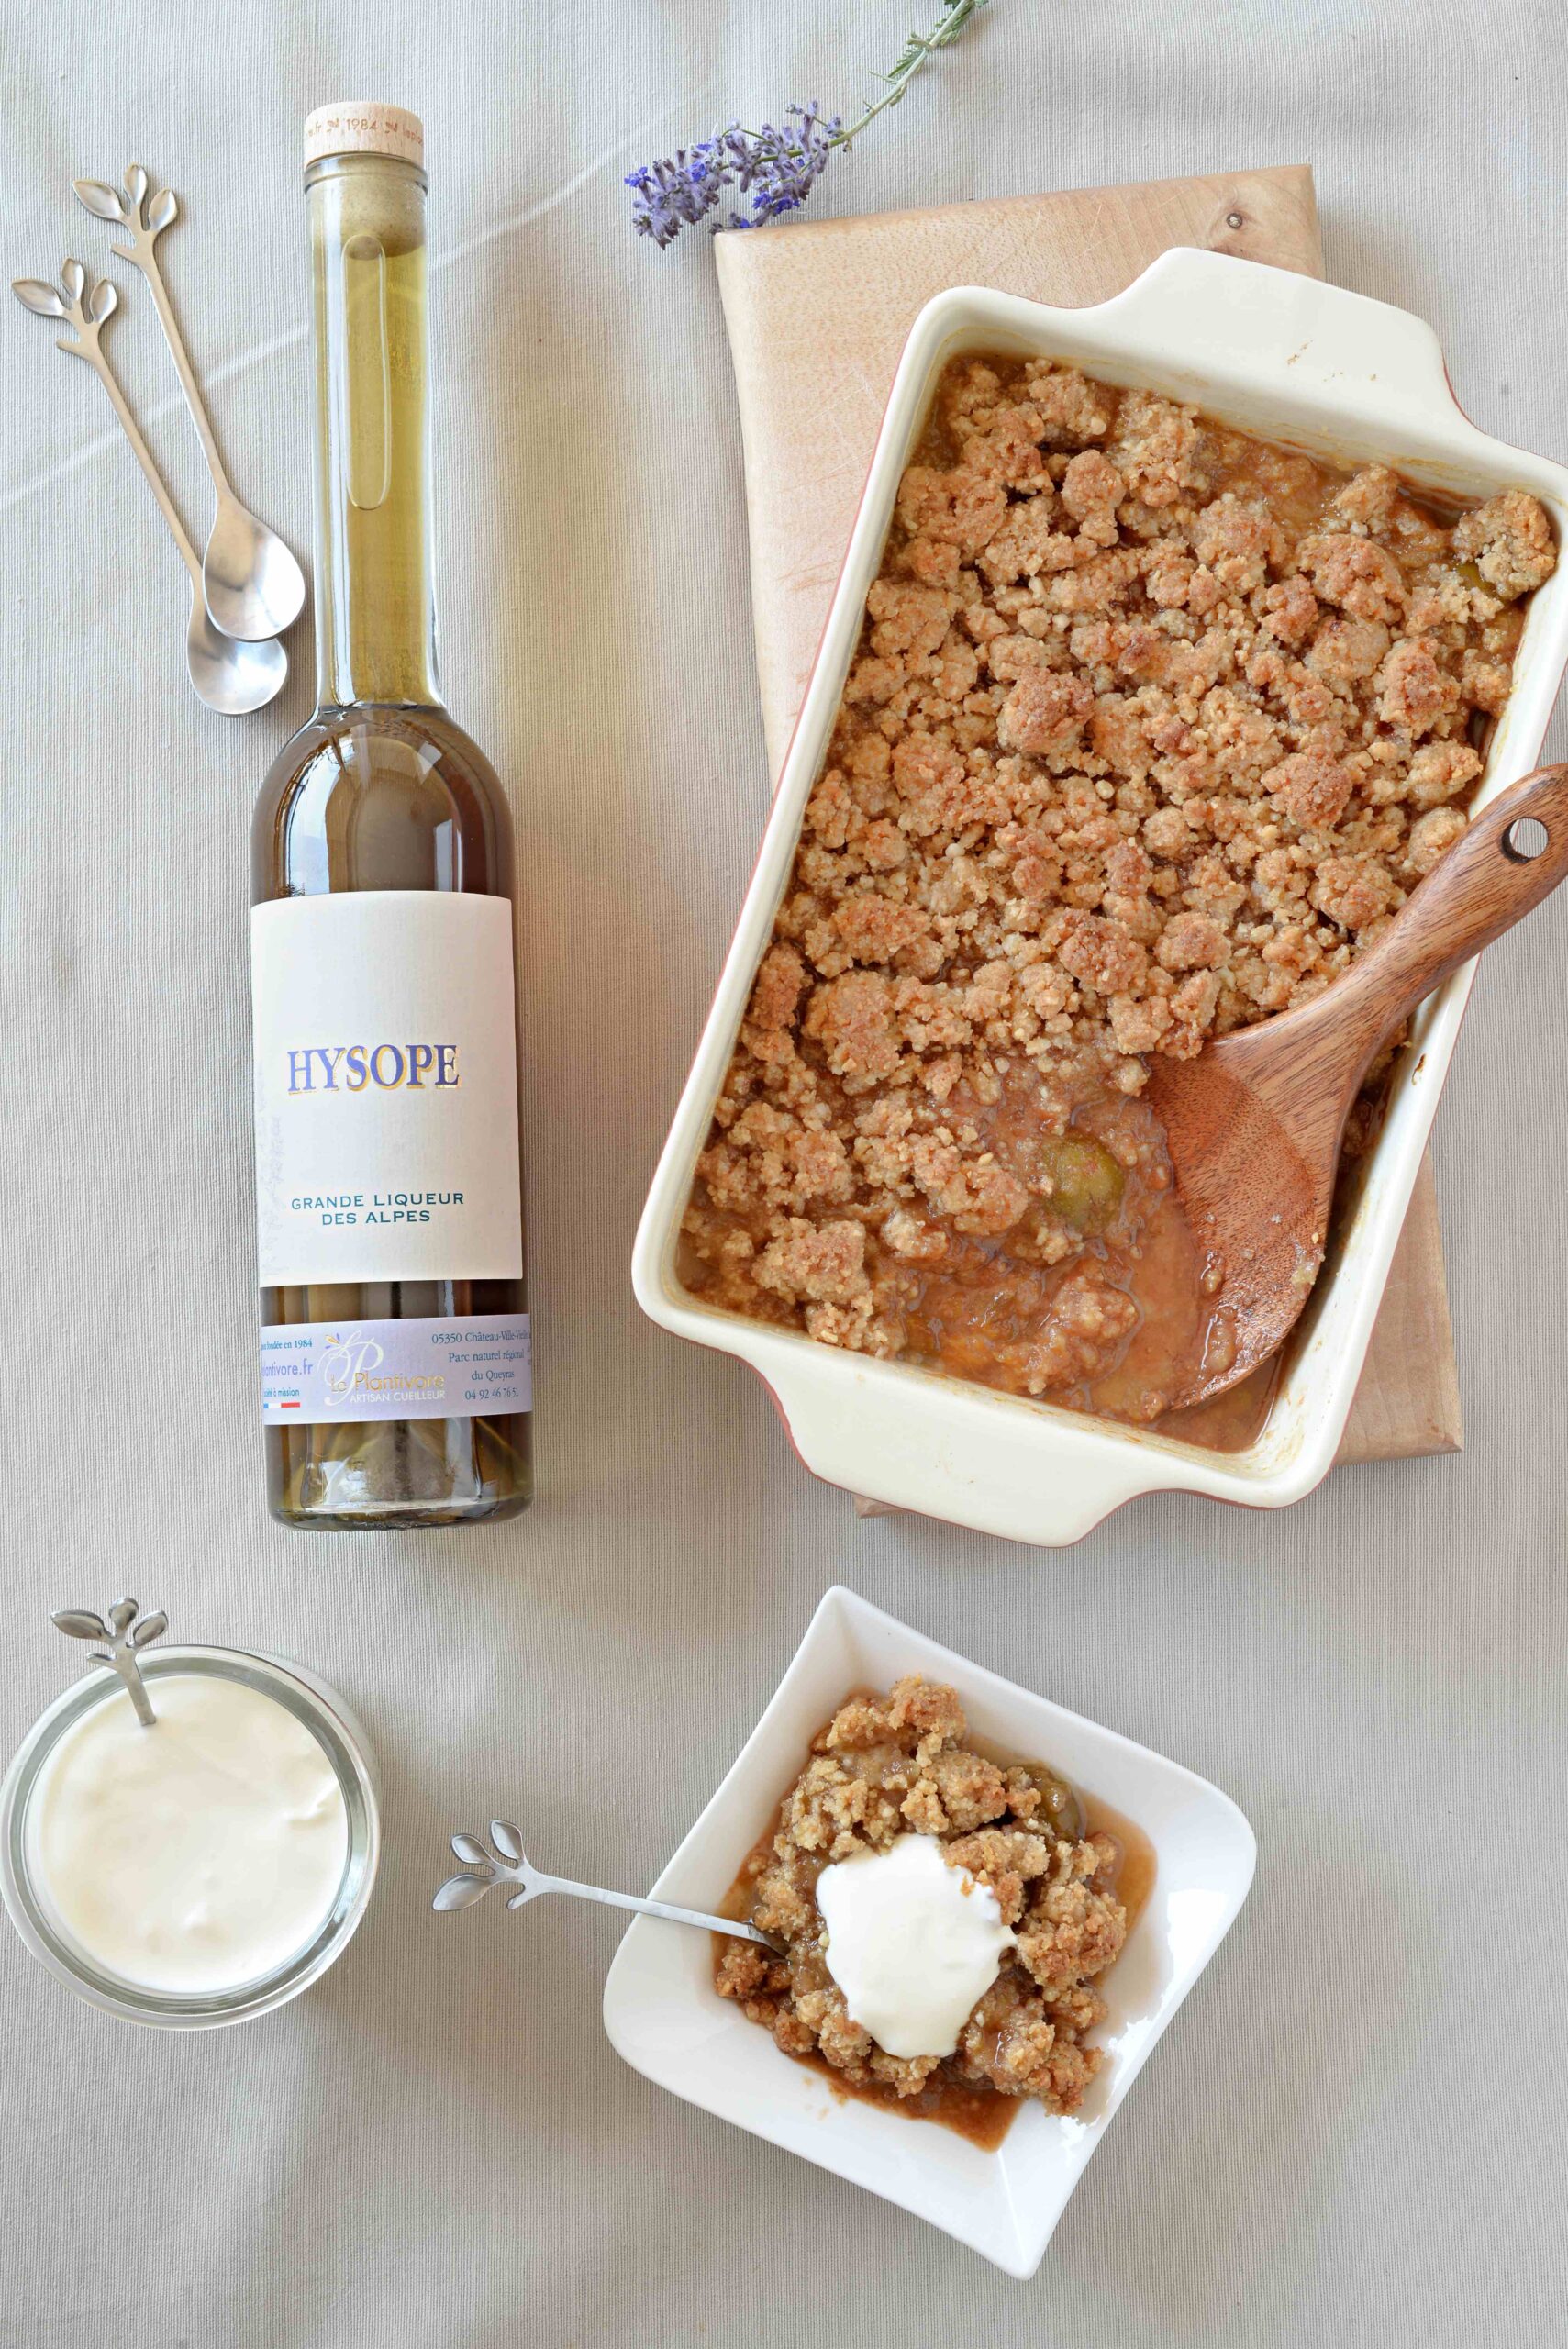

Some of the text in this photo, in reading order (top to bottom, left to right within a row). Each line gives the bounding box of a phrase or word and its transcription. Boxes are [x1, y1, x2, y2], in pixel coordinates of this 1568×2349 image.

[346, 118, 378, 130] 1984
[287, 1043, 460, 1095] HYSOPE
[291, 1192, 464, 1210] GRANDE LIQUEUR
[322, 1209, 431, 1226] DES ALPES
[294, 1338, 313, 1349] 1984
[431, 1333, 462, 1344] 05350
[448, 1353, 470, 1363] Parc
[473, 1351, 501, 1362] naturel
[354, 1371, 446, 1391] Plantivore
[471, 1370, 515, 1382] du Queyras
[278, 1386, 300, 1397] mission
[350, 1390, 446, 1404] ARTISAN CUEILLEUR
[465, 1389, 476, 1400] 04
[479, 1389, 490, 1400] 92
[492, 1387, 502, 1398] 46
[512, 1386, 519, 1397] 51
